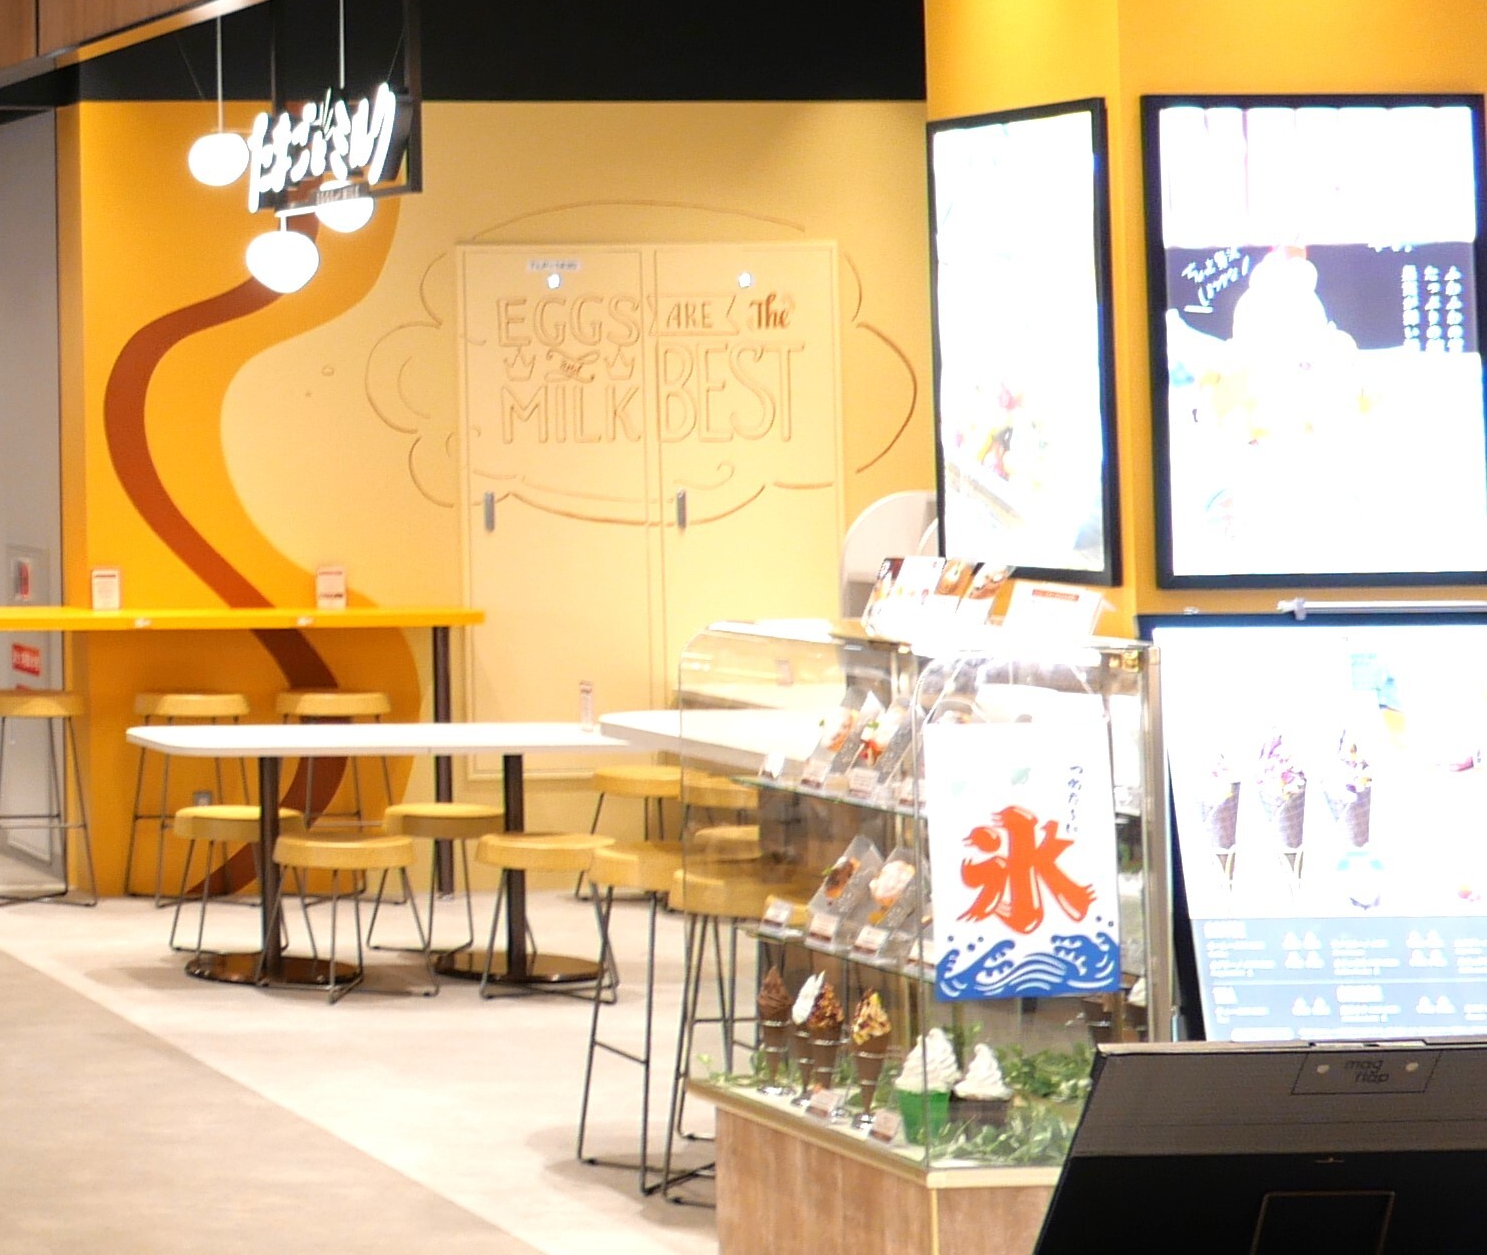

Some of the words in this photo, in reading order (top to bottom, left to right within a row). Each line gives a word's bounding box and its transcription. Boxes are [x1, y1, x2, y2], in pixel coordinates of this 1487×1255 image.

[495, 295, 641, 347] EGGS
[665, 300, 716, 330] ARE
[747, 292, 796, 331] The
[500, 385, 643, 445] MILK
[655, 340, 806, 444] BEST
[955, 804, 1098, 935] 氷
